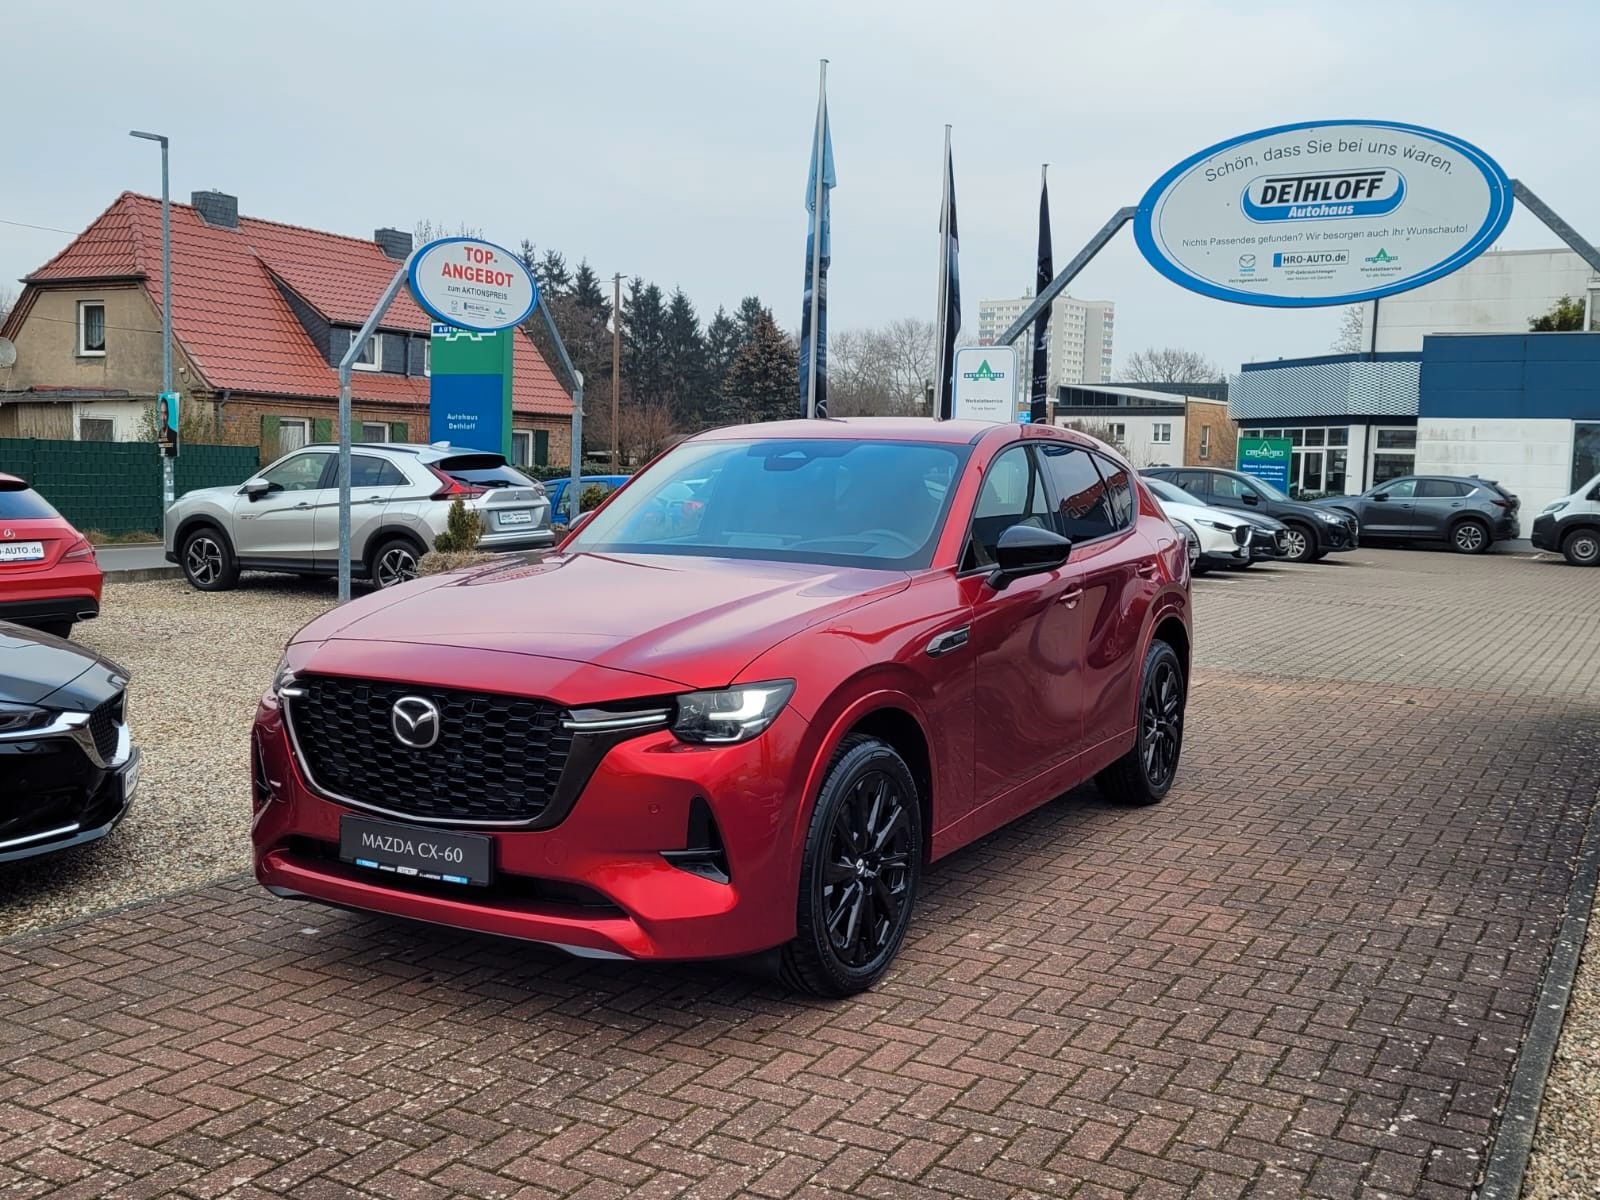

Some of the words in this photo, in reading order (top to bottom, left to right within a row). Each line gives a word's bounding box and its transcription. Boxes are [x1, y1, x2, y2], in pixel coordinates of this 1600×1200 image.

[1205, 156, 1258, 181] Schön,
[1263, 146, 1301, 161] dass
[1307, 140, 1332, 154] Sie
[1338, 138, 1363, 152] bei
[1368, 141, 1398, 156] uns
[1403, 146, 1452, 175] waren.
[1260, 171, 1386, 205] DETHLOFF
[1288, 205, 1354, 218] Autohaus
[1182, 238, 1207, 247] Nichts
[1210, 235, 1256, 246] Passendes
[1258, 233, 1302, 245] gefunden?
[1305, 232, 1320, 240] Wir
[1323, 231, 1365, 240] besorgen
[1367, 228, 1389, 237] auch
[1392, 227, 1404, 236] Ihr
[1407, 224, 1468, 236] Wunschauto!
[464, 246, 498, 265] TOP-
[1283, 253, 1346, 264] HRO-AUTO.de
[441, 262, 514, 288] ANGEBOT
[448, 285, 460, 293] zum
[462, 286, 508, 300] AKTIONSPREIS
[447, 413, 478, 421] Autohaus
[448, 422, 476, 430] Dethloff
[0, 546, 41, 556] -AUTO.de
[361, 832, 415, 856] MAZDA
[418, 842, 463, 863] CX-60
